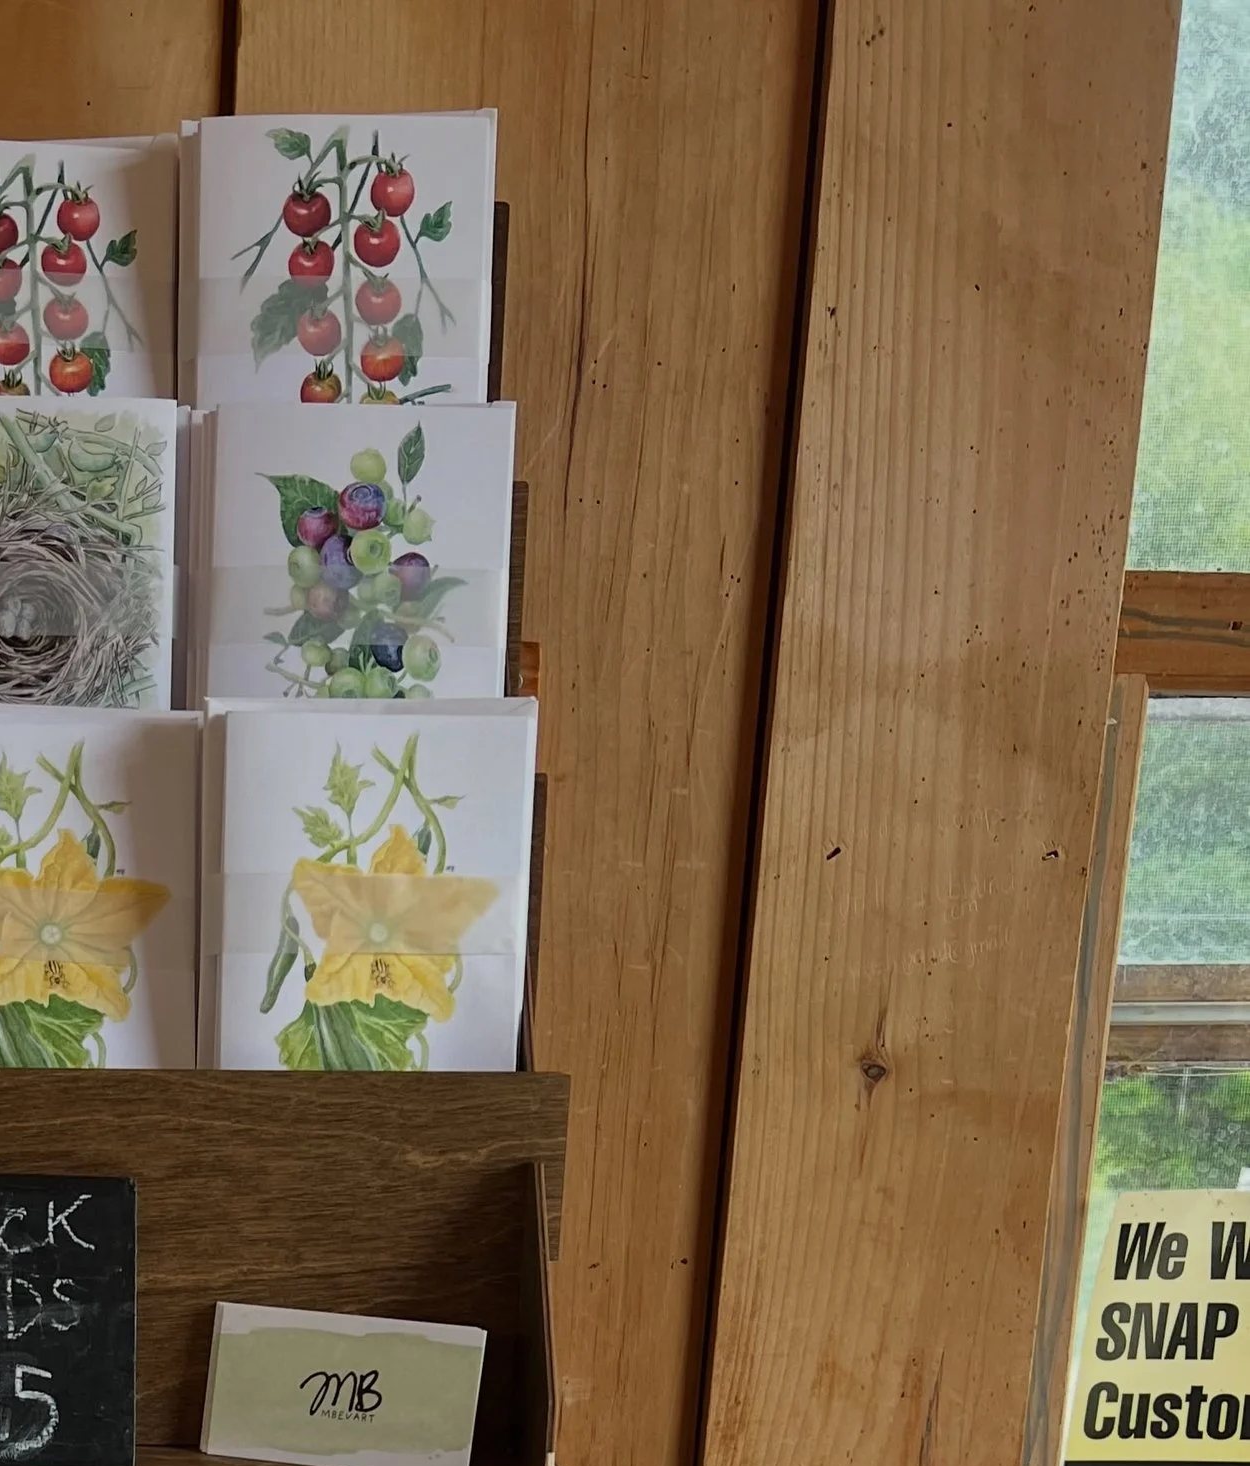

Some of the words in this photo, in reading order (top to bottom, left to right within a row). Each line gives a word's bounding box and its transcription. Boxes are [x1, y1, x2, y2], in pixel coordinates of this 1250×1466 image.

[1113, 1221, 1189, 1280] We
[1095, 1302, 1239, 1361] SNAP
[300, 1370, 382, 1415] MB
[1083, 1381, 1250, 1440] Custo
